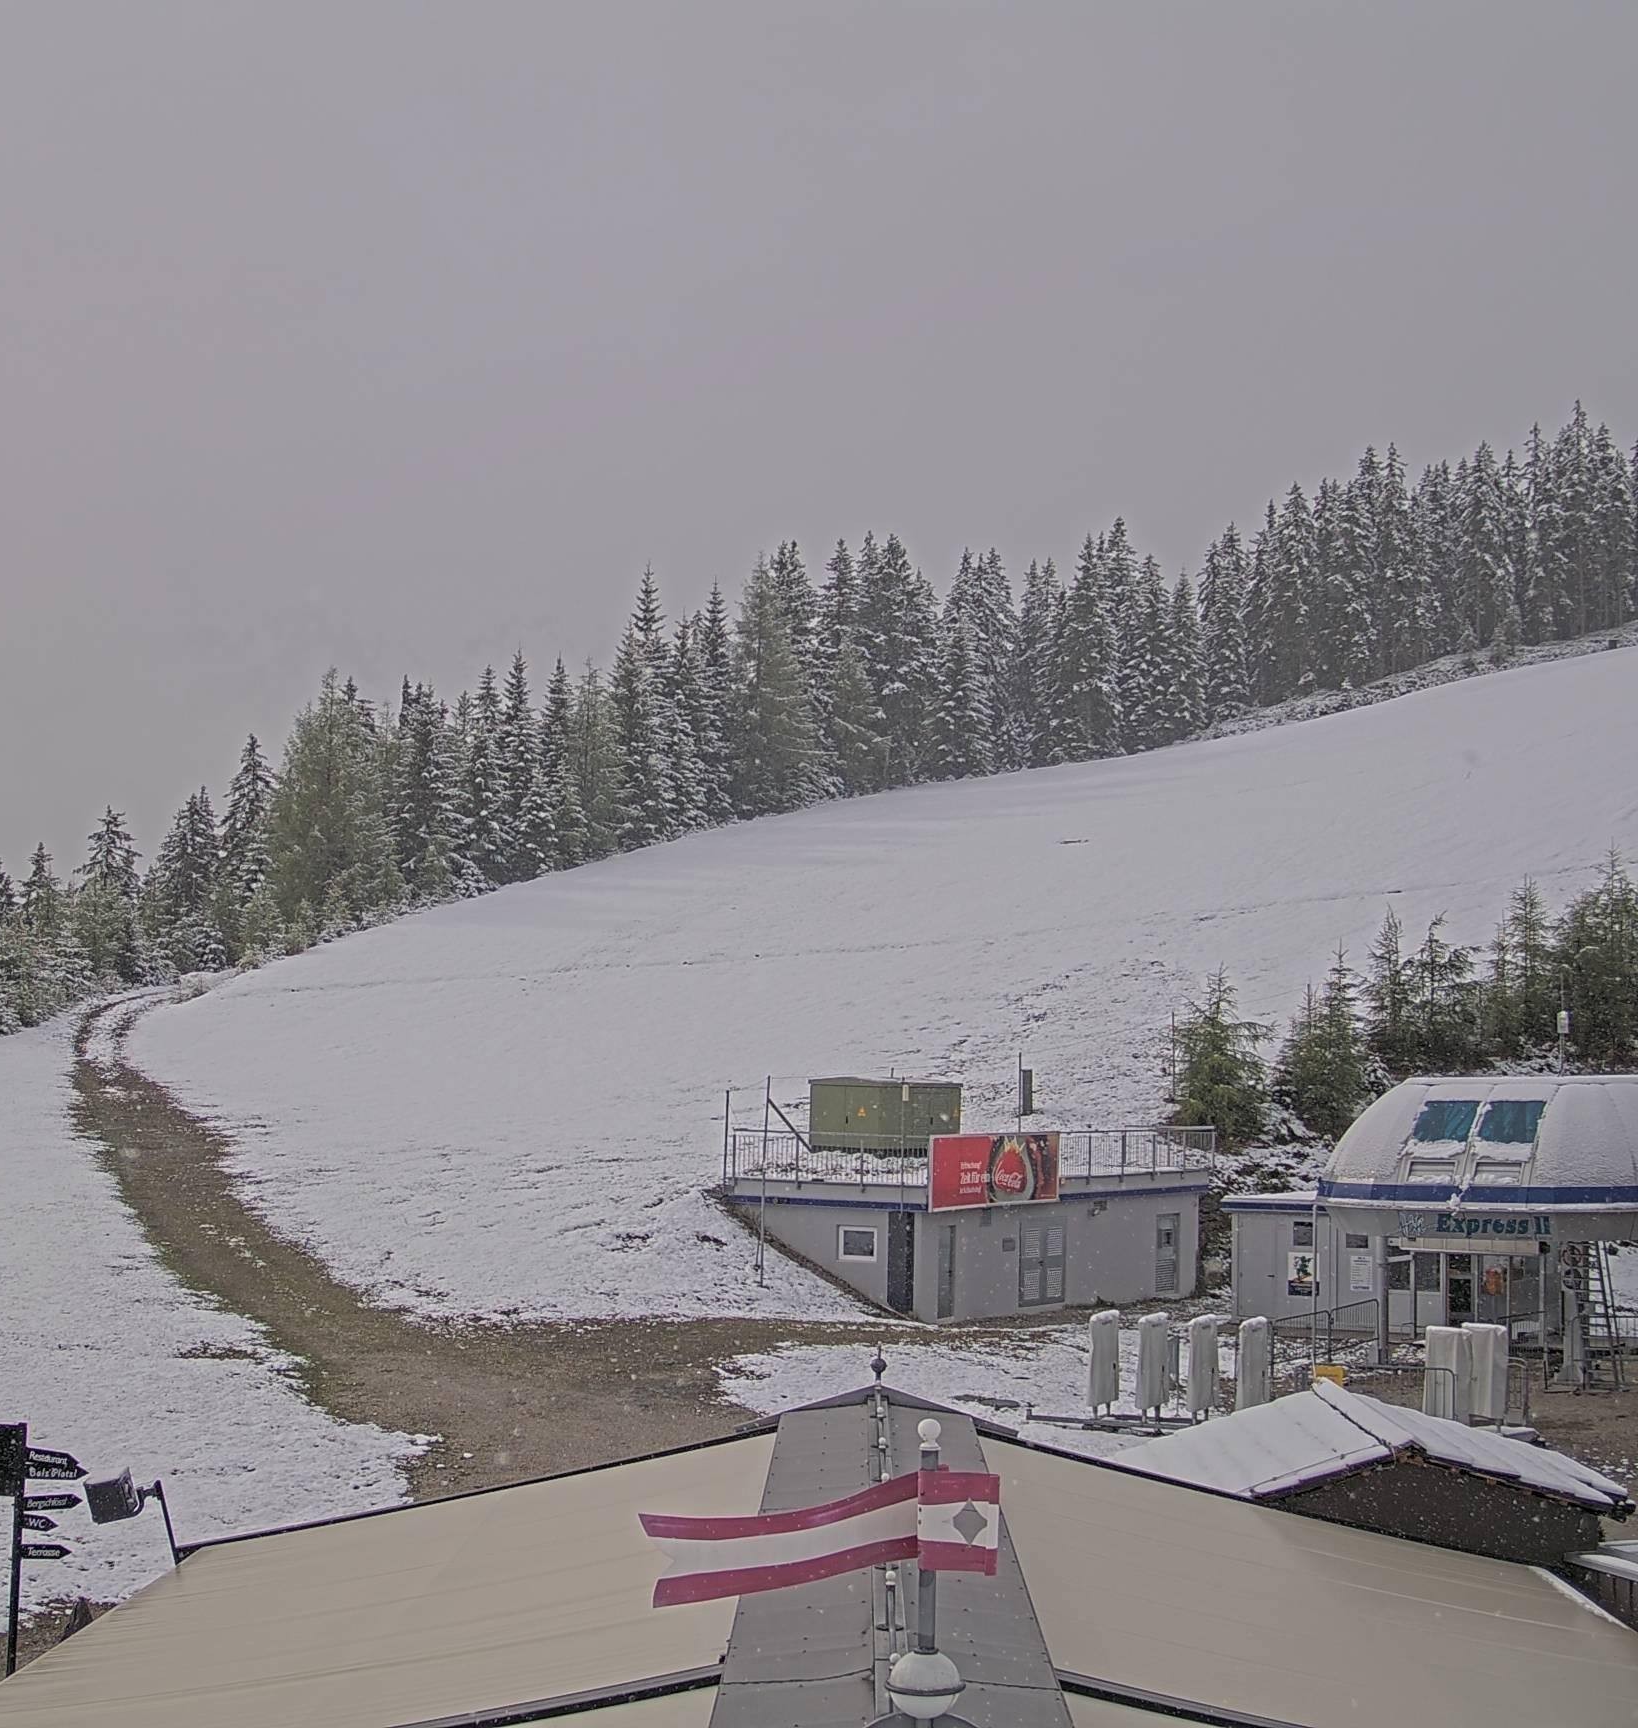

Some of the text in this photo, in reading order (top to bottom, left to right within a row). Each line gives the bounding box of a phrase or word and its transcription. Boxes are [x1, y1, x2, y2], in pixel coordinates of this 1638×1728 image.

[1436, 1213, 1529, 1238] Express
[28, 1518, 46, 1528] WC
[27, 1547, 61, 1557] Terrasse
